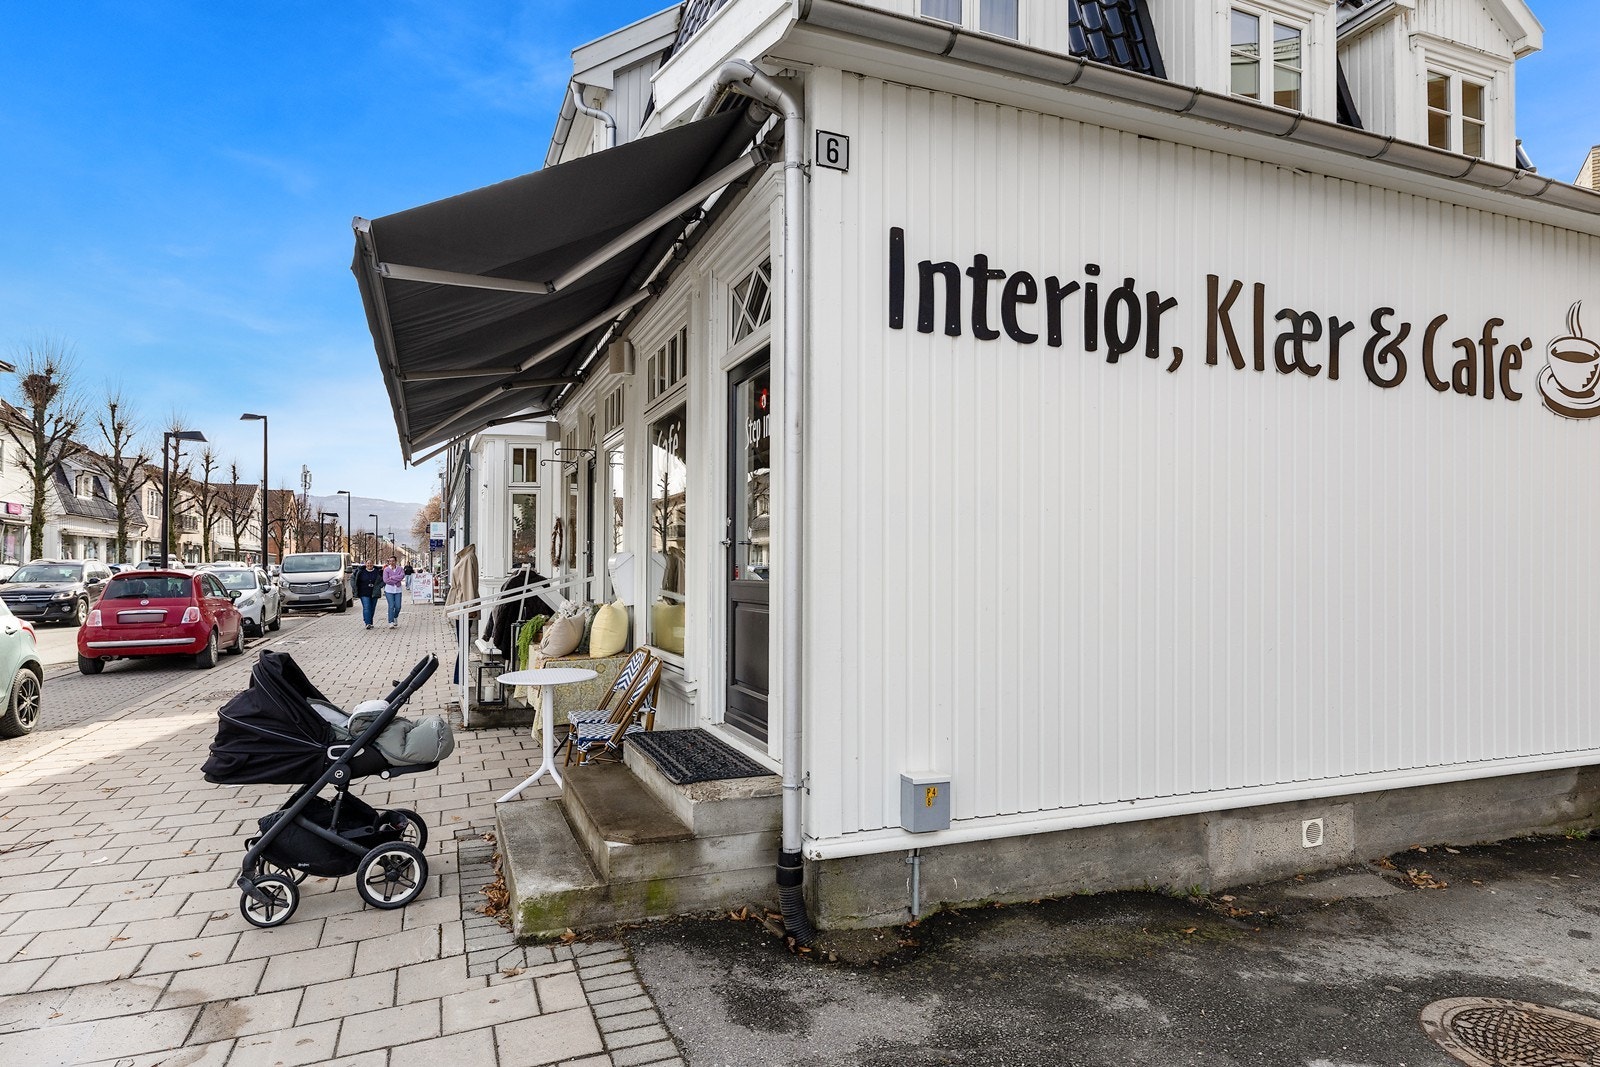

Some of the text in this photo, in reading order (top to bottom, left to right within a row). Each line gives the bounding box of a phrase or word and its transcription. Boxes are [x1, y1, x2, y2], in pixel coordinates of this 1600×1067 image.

[827, 138, 839, 164] 6
[889, 227, 1533, 401] Interiør, Klær & Café
[744, 416, 761, 450] Step
